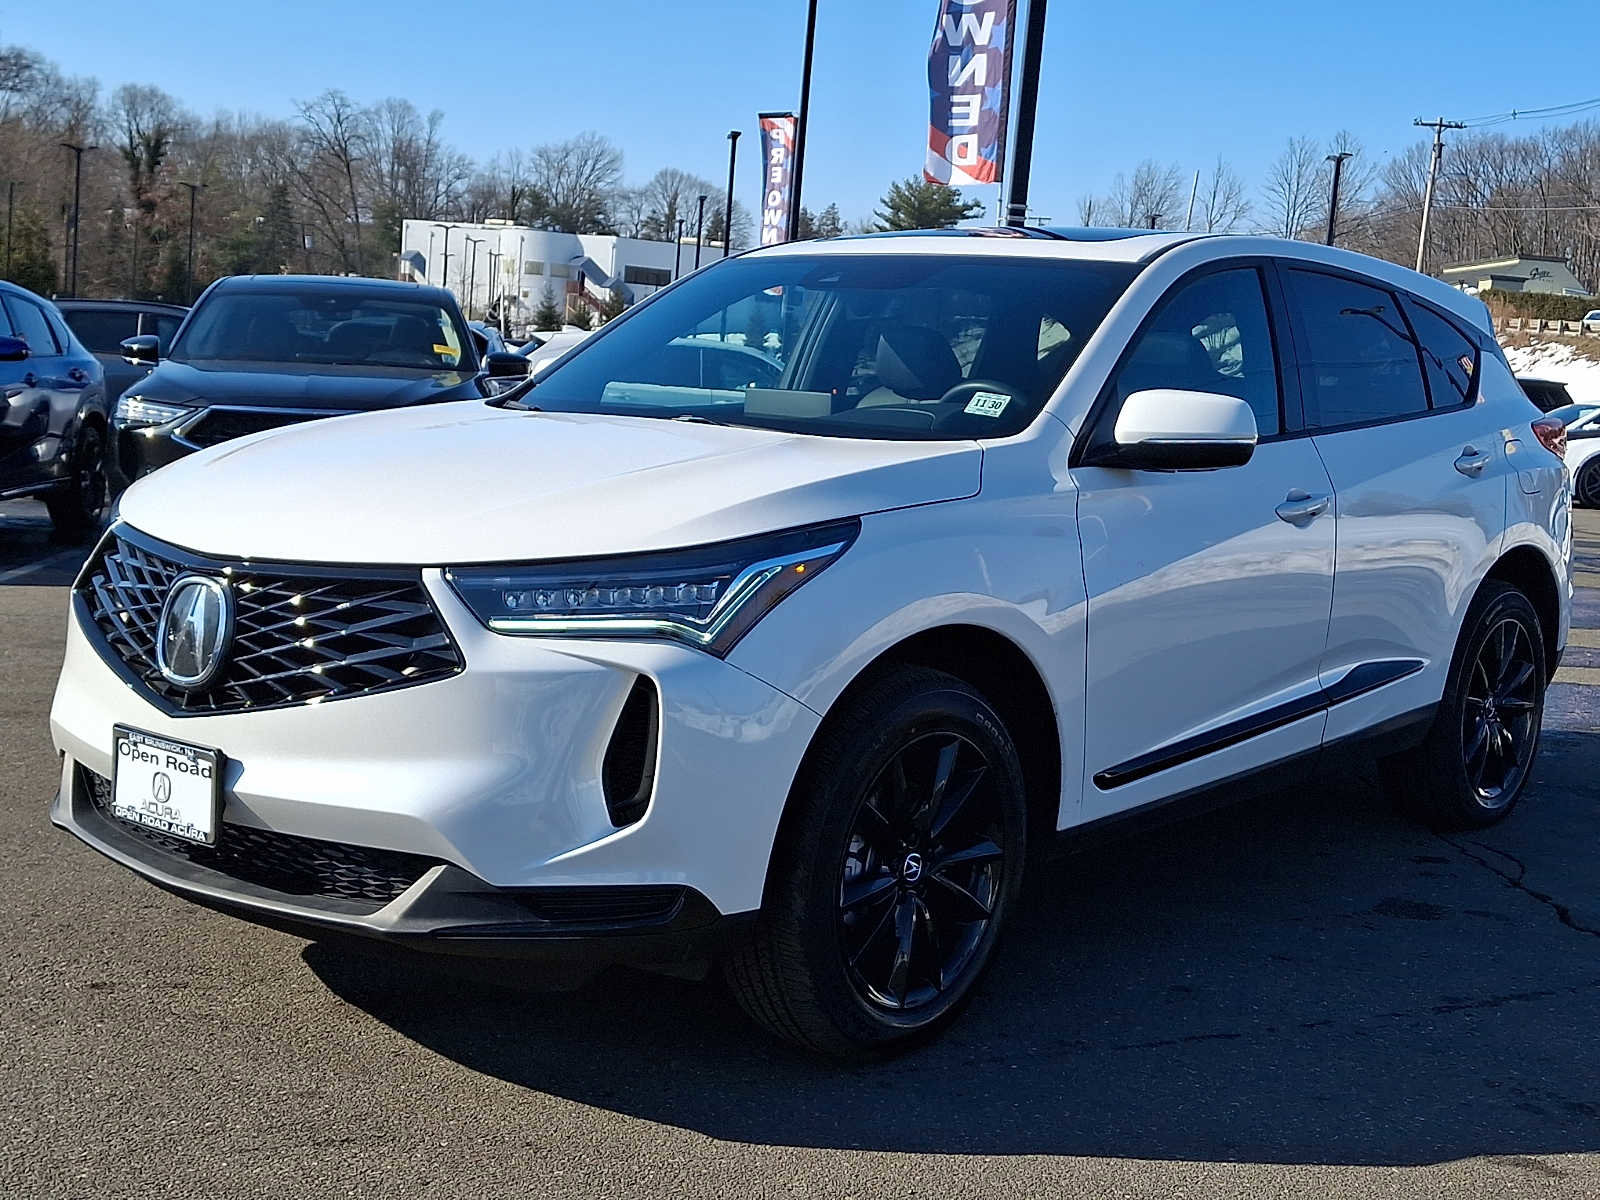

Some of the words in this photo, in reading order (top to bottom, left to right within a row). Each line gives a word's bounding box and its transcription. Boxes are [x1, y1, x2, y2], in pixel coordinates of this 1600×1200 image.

[119, 741, 159, 766] Open
[166, 755, 212, 779] Road
[115, 806, 139, 822] OPEN
[141, 813, 169, 830] ROAD
[170, 822, 206, 841] ACURA
